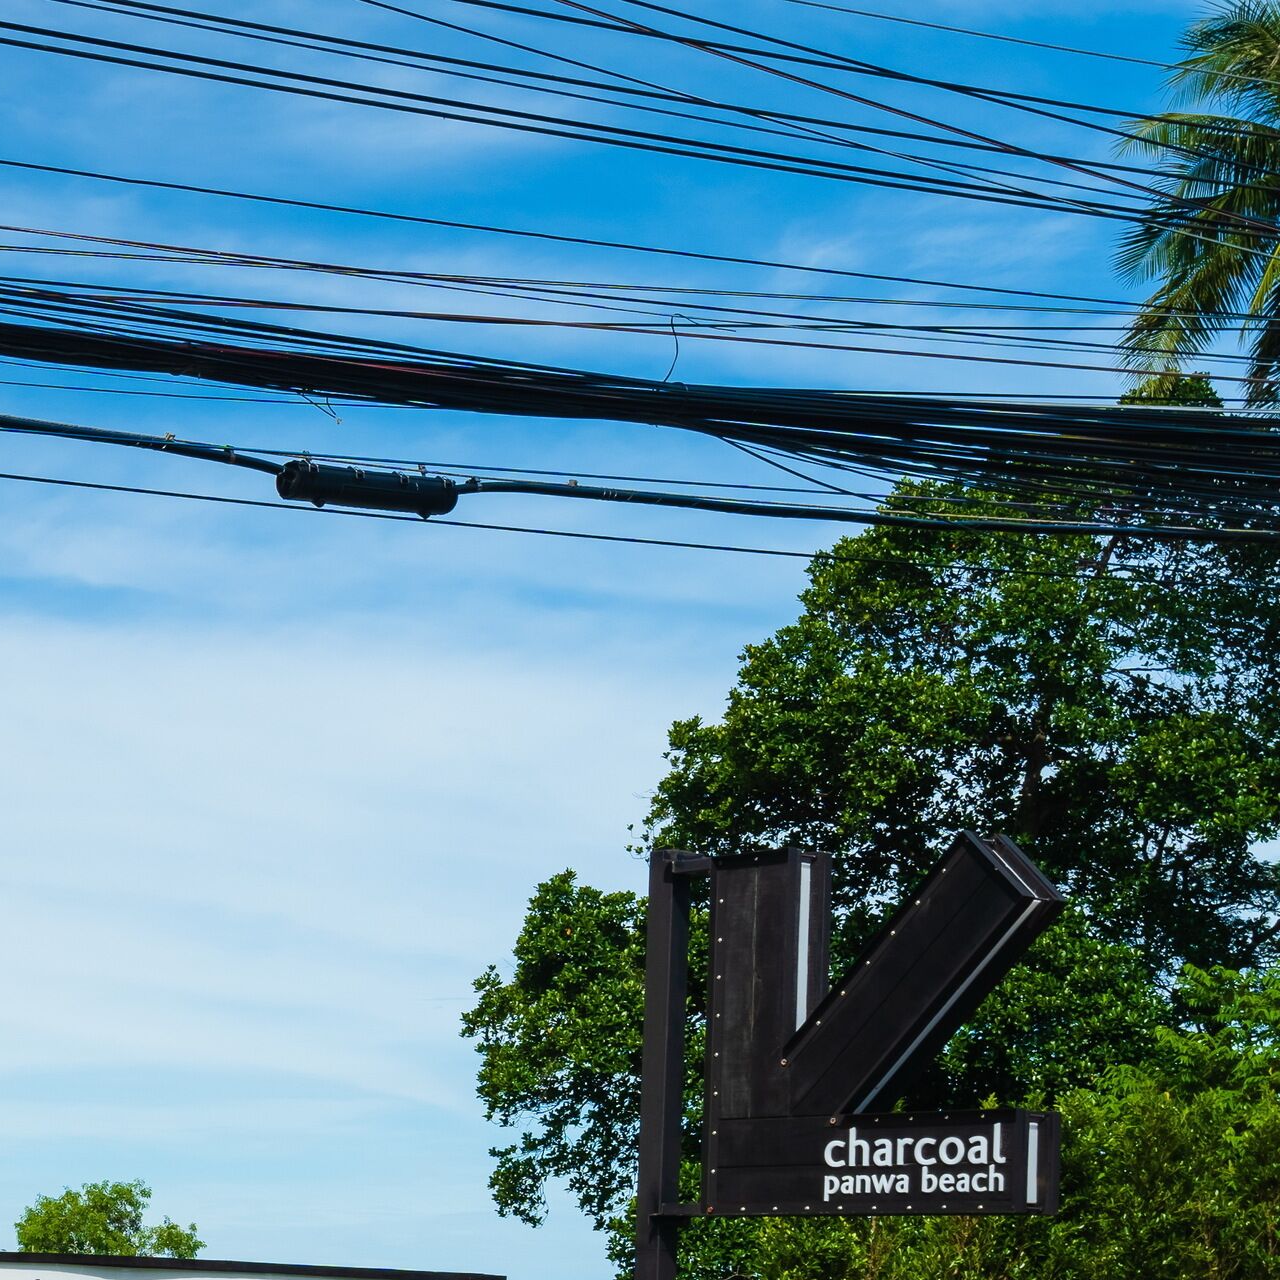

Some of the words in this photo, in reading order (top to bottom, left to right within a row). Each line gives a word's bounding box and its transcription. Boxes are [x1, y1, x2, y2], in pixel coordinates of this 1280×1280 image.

[823, 1121, 1007, 1168] charcoal
[823, 1172, 910, 1202] panwa
[921, 1165, 1004, 1194] beach
